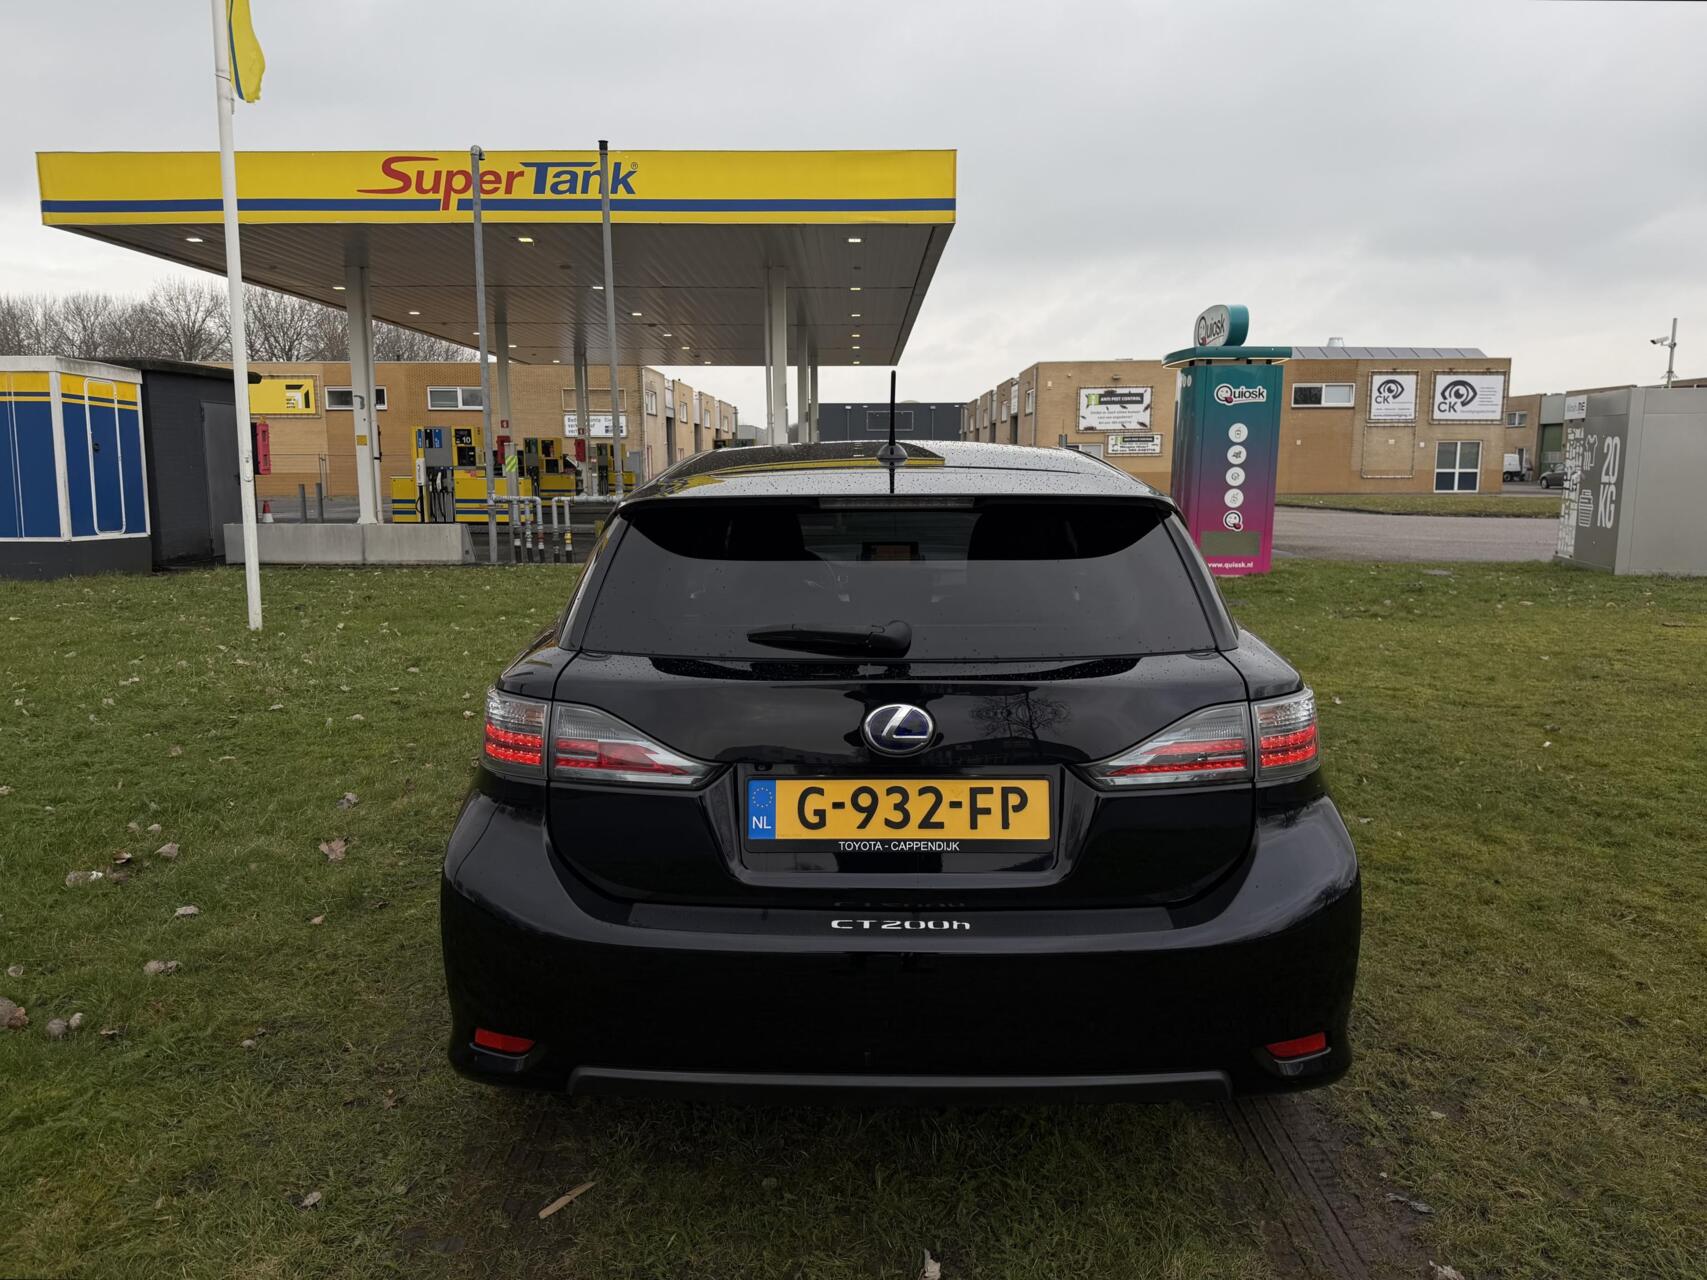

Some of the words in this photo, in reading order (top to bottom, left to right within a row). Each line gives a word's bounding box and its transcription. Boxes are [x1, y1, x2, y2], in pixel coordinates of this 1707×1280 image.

[1197, 313, 1225, 346] Quiosk
[1215, 385, 1265, 403] Quiosk
[1375, 395, 1390, 404] CK
[1437, 401, 1457, 413] CK
[1601, 436, 1621, 483] 20
[1597, 484, 1617, 528] KG
[797, 786, 1028, 830] G-932-FP
[752, 816, 771, 829] NL
[838, 841, 882, 851] TOYOTA
[890, 841, 960, 851] CAPPENDIJK
